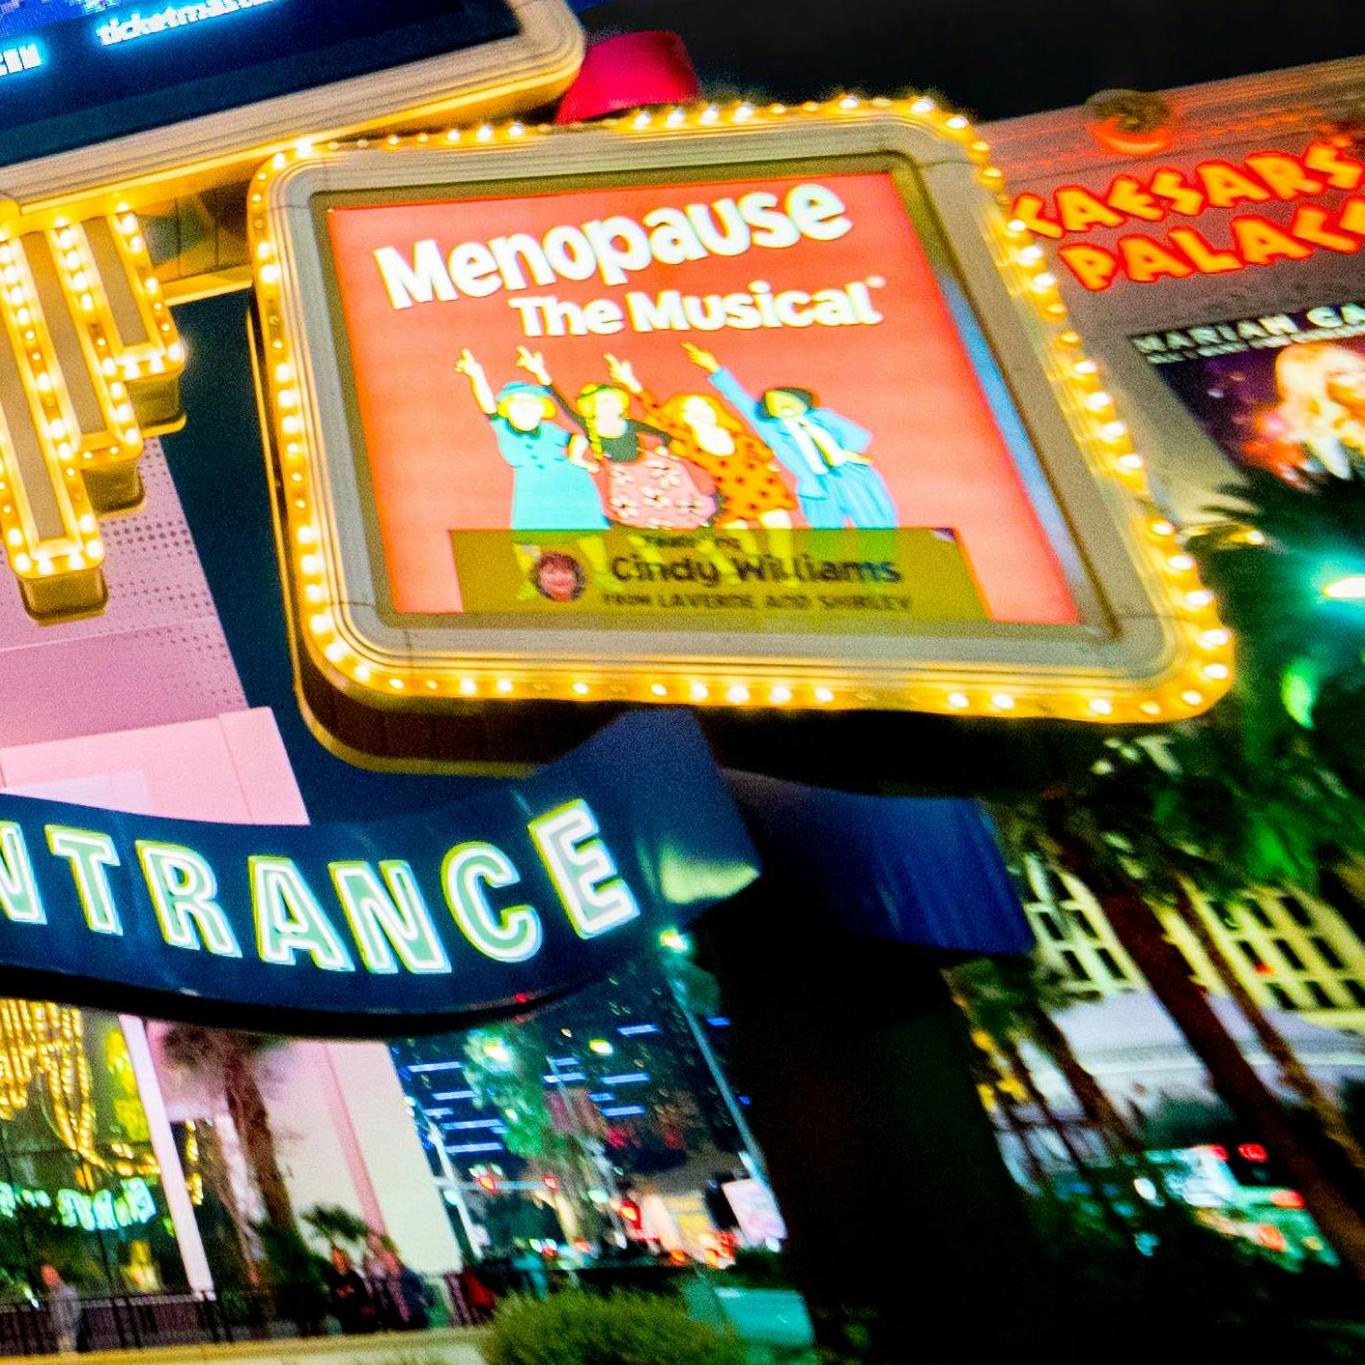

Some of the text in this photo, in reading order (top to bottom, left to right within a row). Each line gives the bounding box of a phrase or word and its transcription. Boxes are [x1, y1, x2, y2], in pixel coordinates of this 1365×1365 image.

[373, 183, 853, 309] Menopause
[508, 279, 883, 337] The Musical
[611, 554, 903, 587] Cindy Williams
